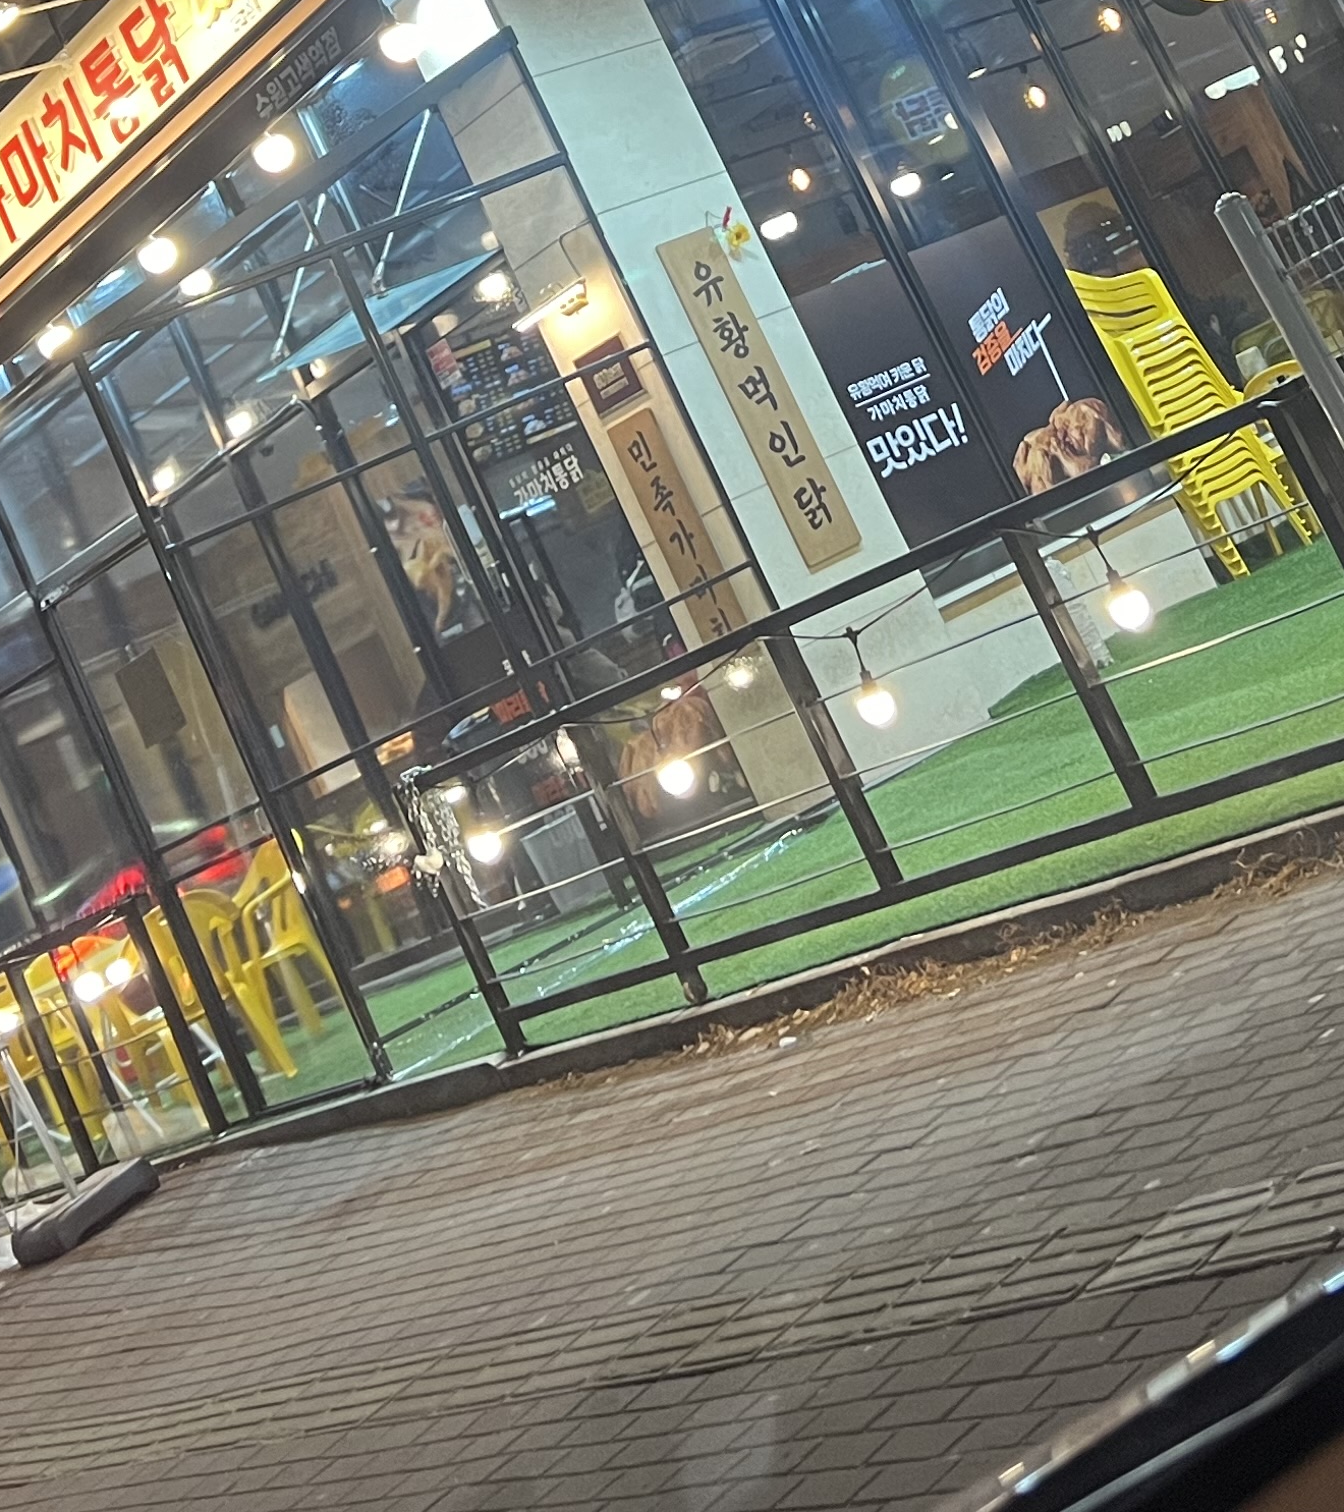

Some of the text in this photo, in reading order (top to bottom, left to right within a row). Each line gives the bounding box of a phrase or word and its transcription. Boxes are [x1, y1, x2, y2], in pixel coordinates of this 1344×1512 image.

[256, 27, 342, 120] 수원고색역점
[972, 320, 1024, 376] 검증을
[866, 384, 931, 421] 가마치통닭
[866, 402, 969, 478] 맛있다!
[513, 454, 584, 506] 가마치통닭
